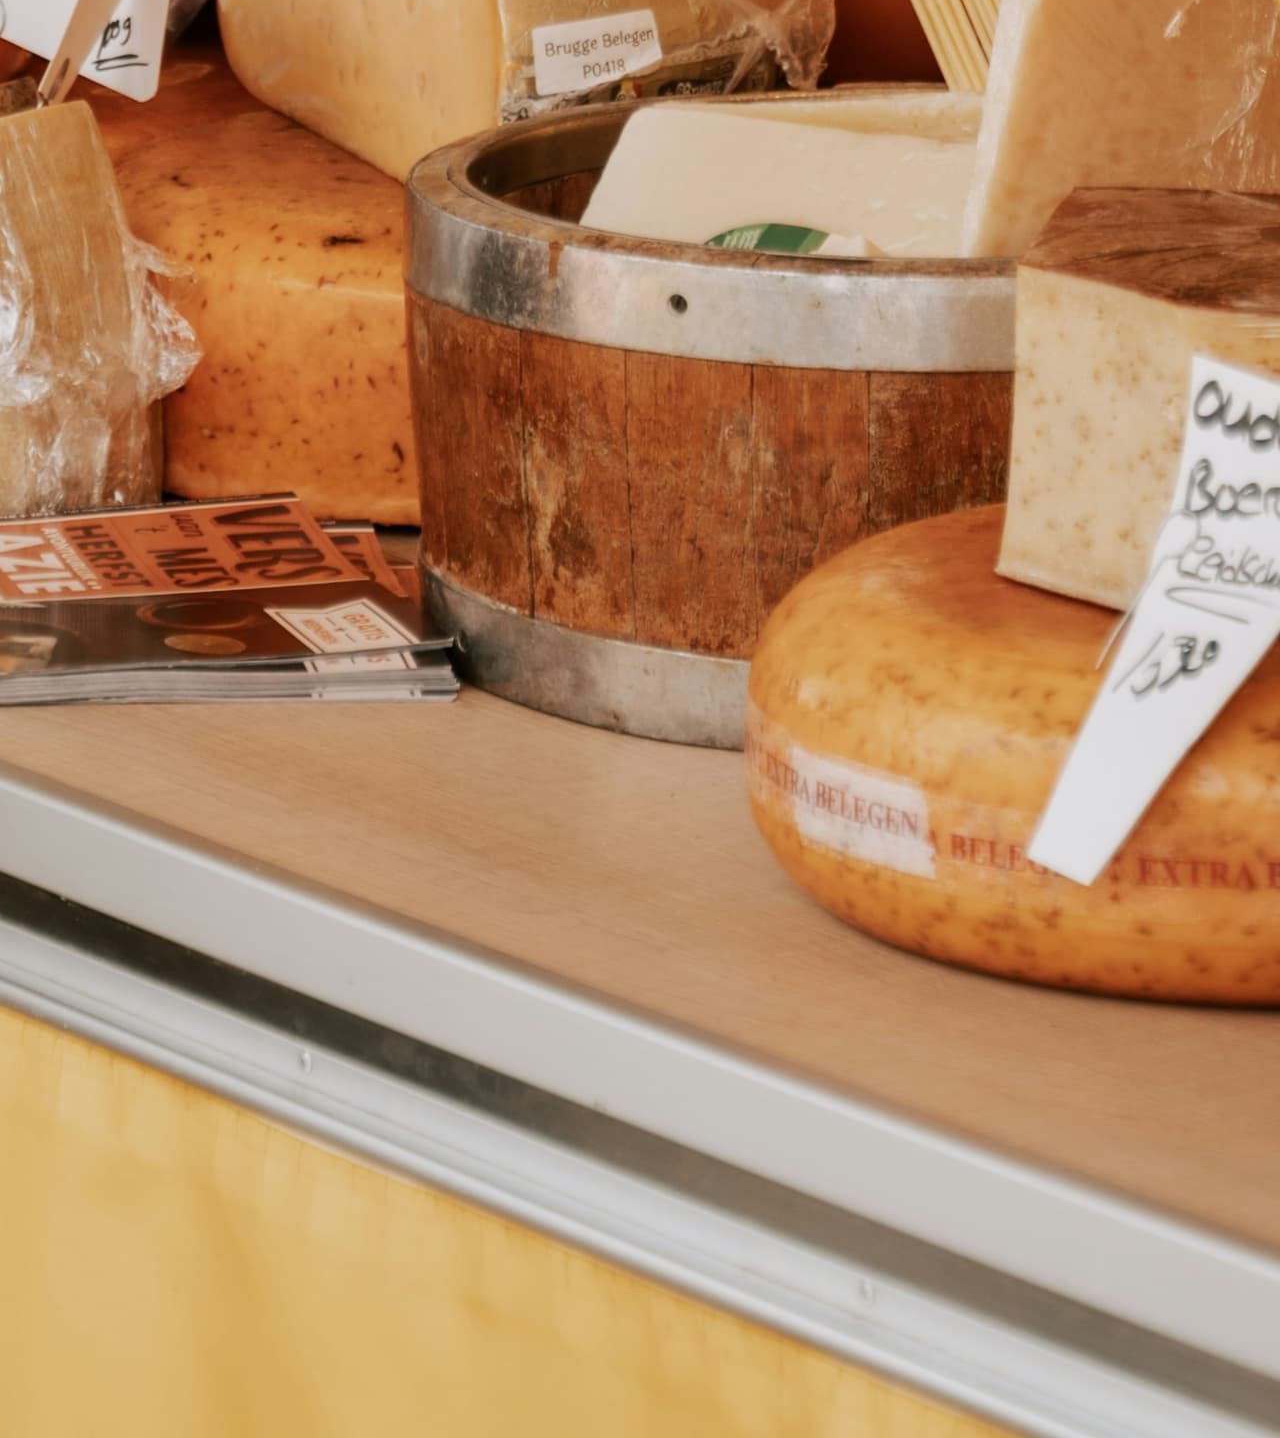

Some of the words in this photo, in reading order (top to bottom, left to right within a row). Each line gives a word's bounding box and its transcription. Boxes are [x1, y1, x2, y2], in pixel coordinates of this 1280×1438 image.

[544, 35, 599, 60] Brugge
[601, 26, 655, 53] Belegen
[64, 523, 153, 588] HERFST
[147, 547, 241, 588] MES
[212, 505, 343, 581] VERS
[814, 781, 920, 839] BELEGEN
[1136, 858, 1256, 892] EXTRA
